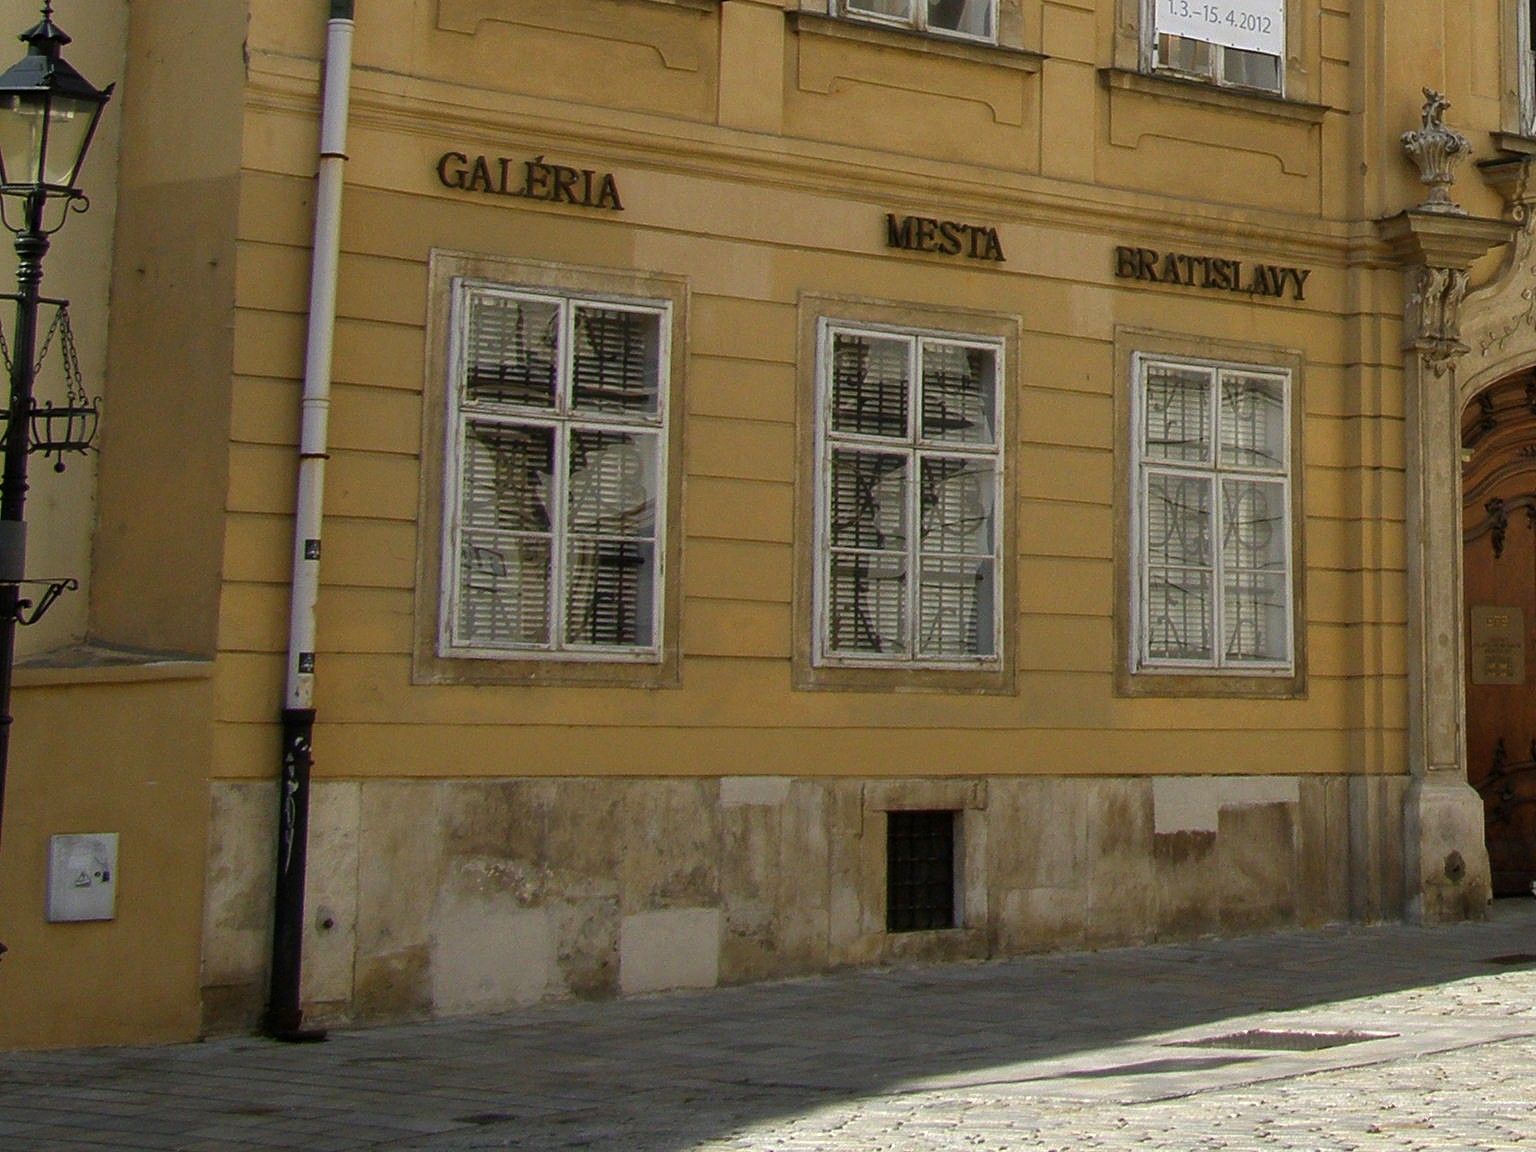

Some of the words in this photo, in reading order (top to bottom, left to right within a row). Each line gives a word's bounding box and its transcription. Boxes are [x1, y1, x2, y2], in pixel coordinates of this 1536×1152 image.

[436, 151, 625, 211] GALÉRIA
[886, 213, 1007, 262] MESTA
[1114, 246, 1312, 301] BRATISLAVY
